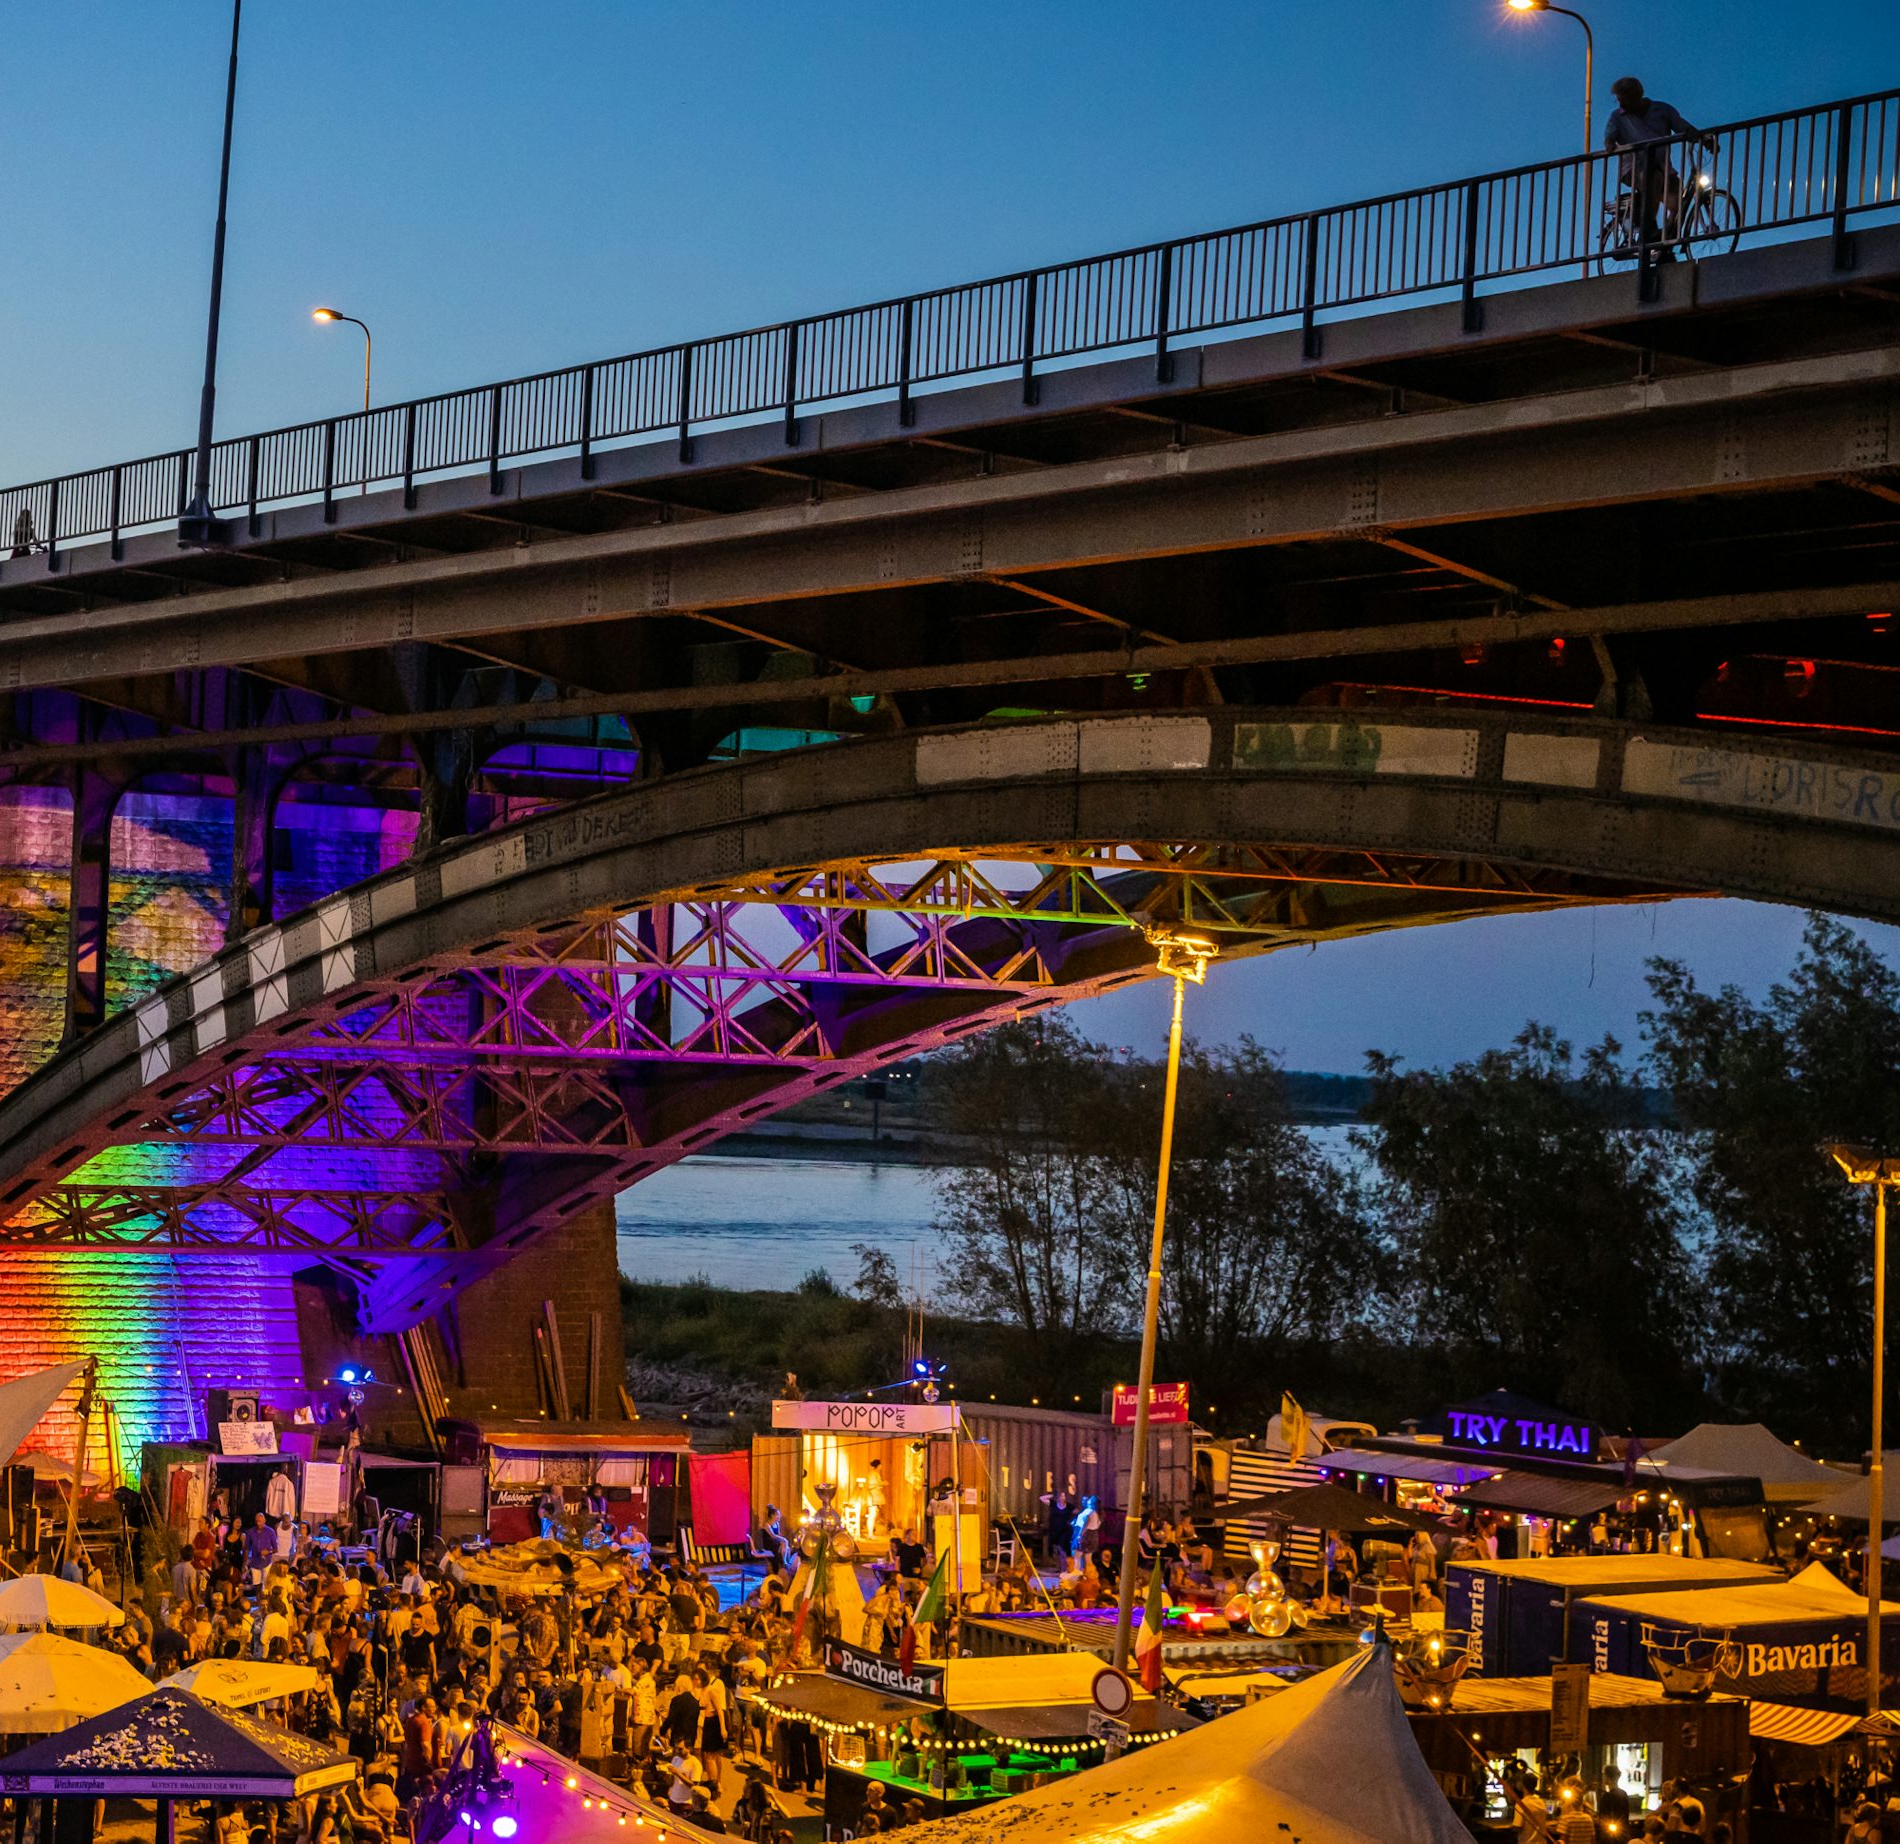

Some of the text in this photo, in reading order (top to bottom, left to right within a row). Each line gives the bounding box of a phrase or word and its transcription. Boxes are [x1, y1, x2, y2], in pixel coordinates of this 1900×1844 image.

[827, 1405, 905, 1429] POPOP ART
[1447, 1411, 1590, 1453] TRY THAI
[497, 1489, 534, 1505] Massage
[1467, 1578, 1485, 1669] Bavaria
[824, 1643, 923, 1694] I Porchetta
[1747, 1633, 1858, 1677] Bavaria
